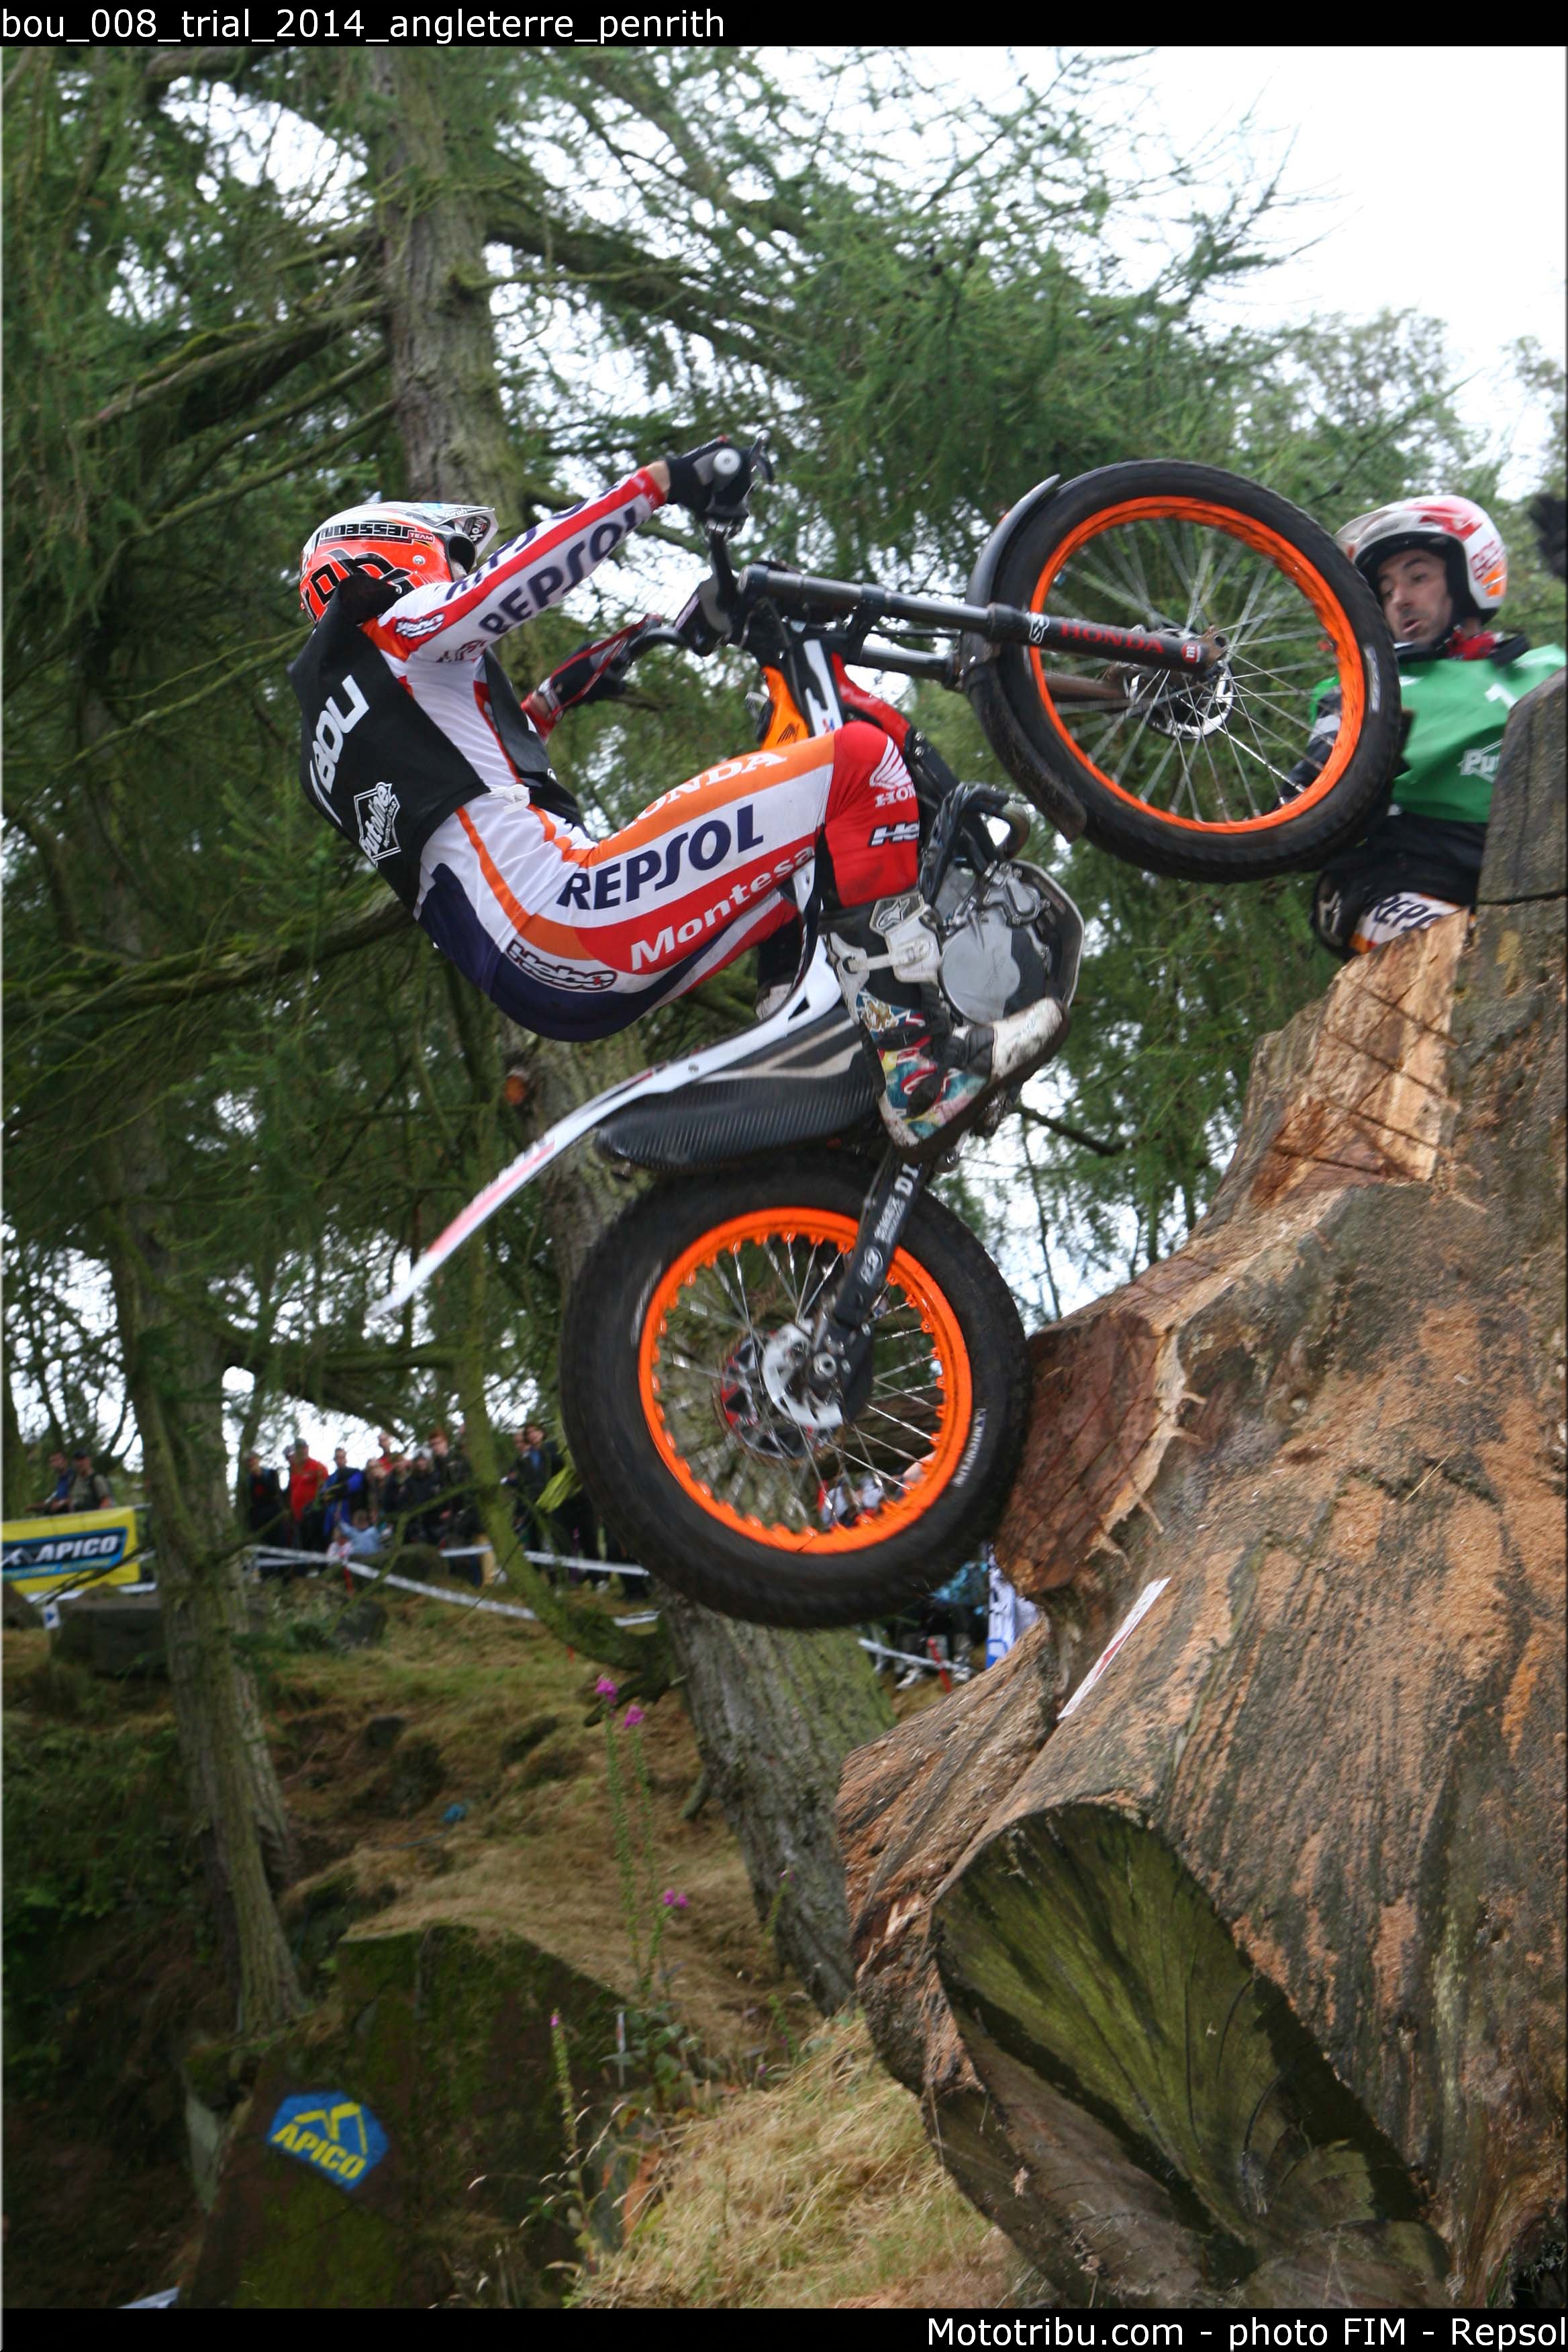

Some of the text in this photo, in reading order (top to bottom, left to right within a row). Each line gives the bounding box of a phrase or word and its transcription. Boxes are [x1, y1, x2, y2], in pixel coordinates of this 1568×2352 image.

[409, 532, 434, 542] TEAM
[1060, 622, 1165, 654] HONDA
[312, 674, 370, 794] BOU
[875, 783, 916, 808] HON
[556, 803, 764, 910] REPSOL
[630, 845, 816, 971] Montesa
[35, 1534, 119, 1563] APICO
[271, 2122, 366, 2179] APICO
